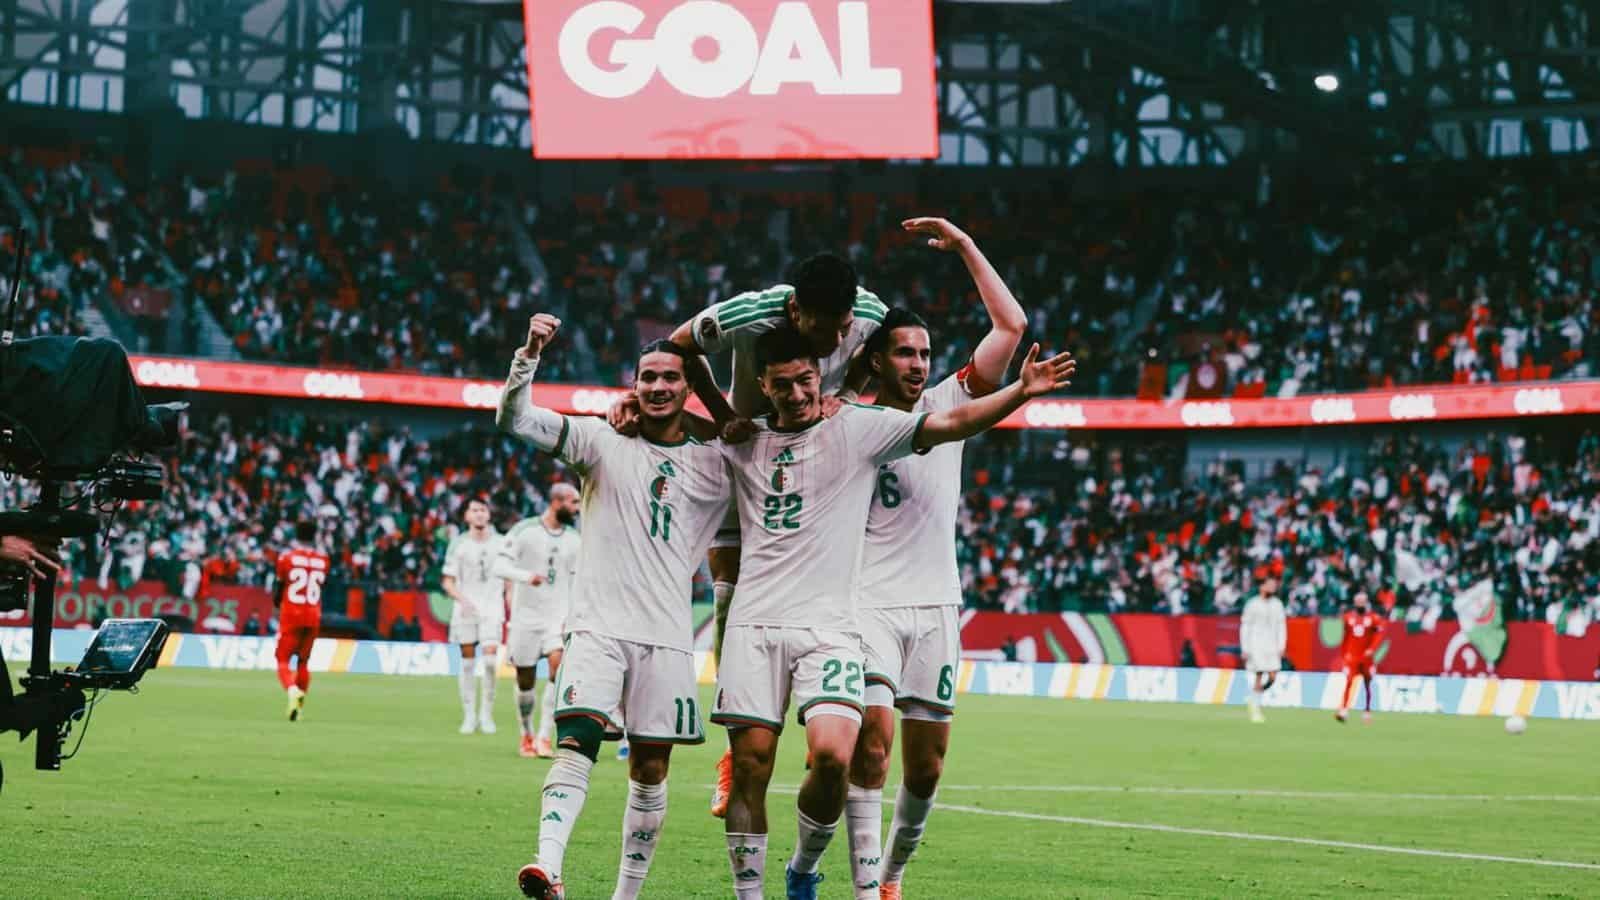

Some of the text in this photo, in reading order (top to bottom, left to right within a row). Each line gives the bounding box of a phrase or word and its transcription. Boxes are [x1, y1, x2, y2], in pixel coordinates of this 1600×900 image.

[558, 0, 902, 98] GOAL
[137, 361, 199, 387] GOAL
[303, 372, 364, 398] GOAL
[1025, 402, 1086, 426] GOAL
[1181, 402, 1234, 426] GOAL
[1311, 398, 1355, 422] GOAL
[1389, 394, 1437, 420] GOAL
[1513, 388, 1563, 414] GOAL
[879, 471, 901, 508] 6
[649, 500, 671, 541] 11
[764, 494, 803, 530] 22
[288, 568, 326, 606] 26
[205, 598, 239, 624] 25
[375, 643, 449, 675] VISA
[822, 658, 862, 695] 22
[937, 664, 953, 701] 6
[987, 664, 1034, 695] VISA
[1126, 668, 1177, 702] VISA
[1378, 676, 1437, 712] VISA
[675, 697, 696, 734] 11
[544, 790, 568, 799] FAF
[735, 845, 758, 856] FAF
